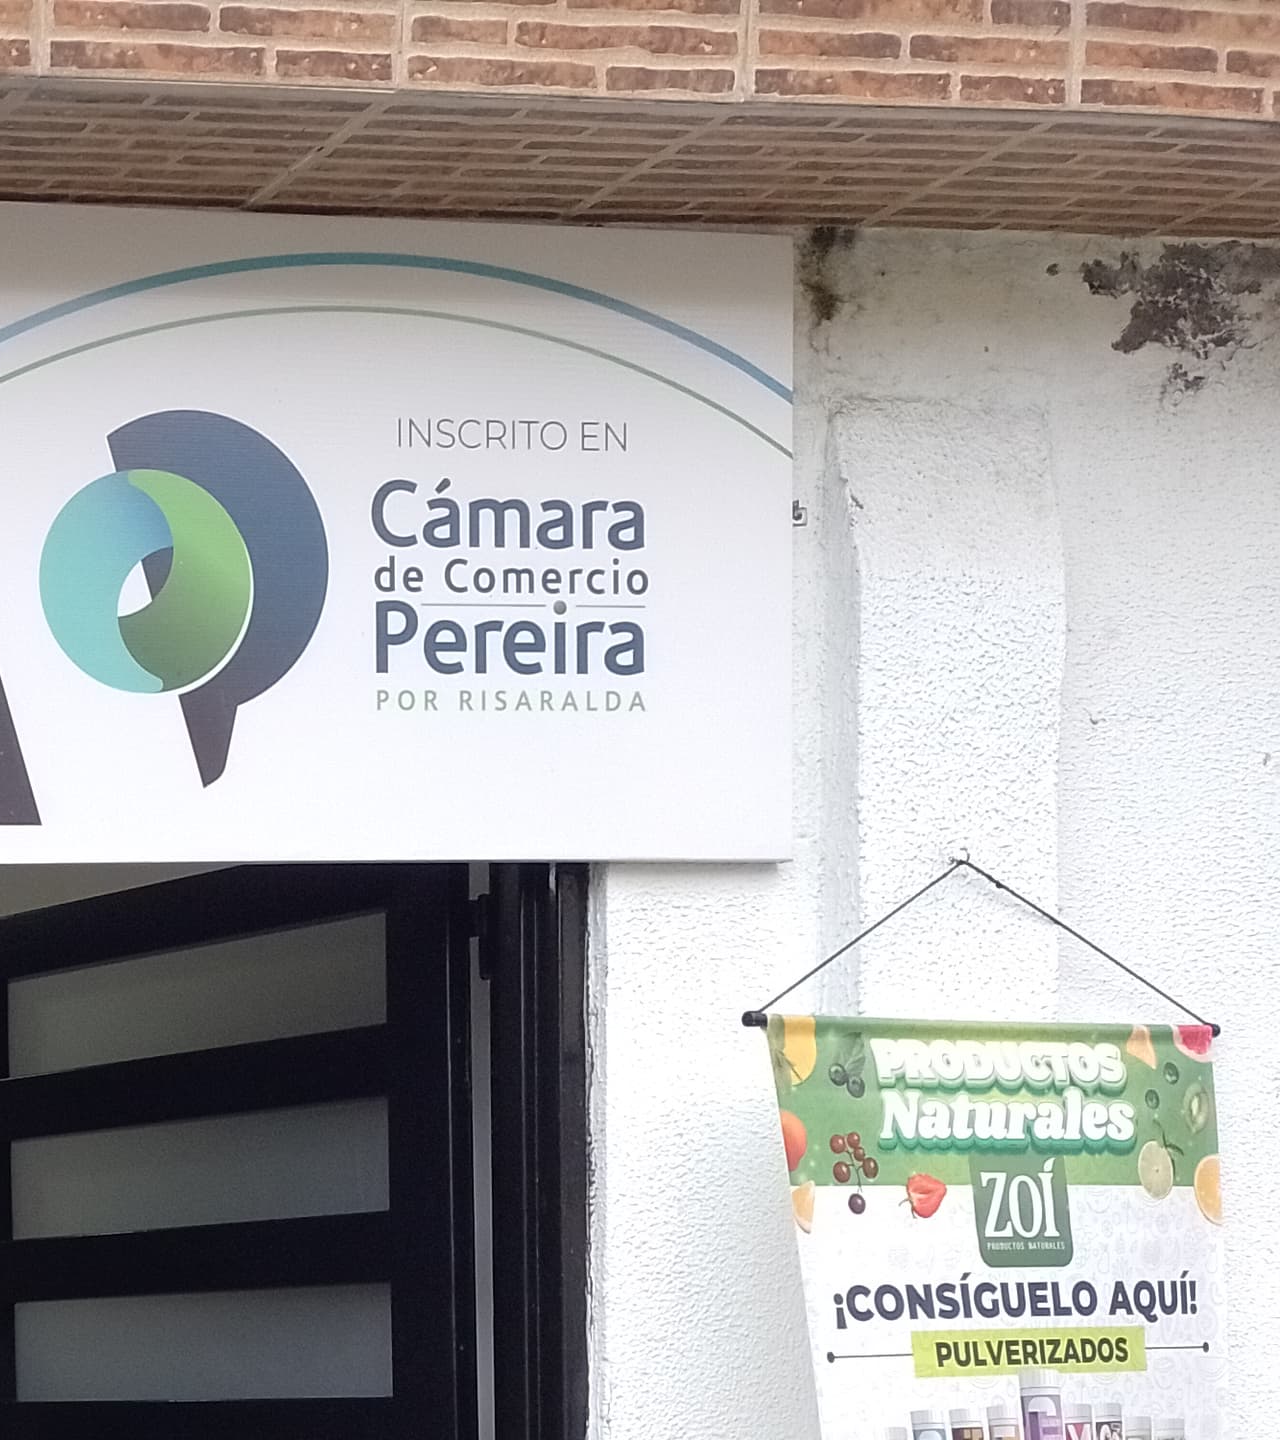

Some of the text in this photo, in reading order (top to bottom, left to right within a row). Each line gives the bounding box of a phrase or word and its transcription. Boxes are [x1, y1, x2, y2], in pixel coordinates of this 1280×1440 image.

[397, 417, 627, 452] INSCRITO EN
[371, 478, 645, 550] Cámara
[374, 555, 649, 595] de Comercio
[375, 599, 645, 676] Pereira
[376, 690, 646, 712] POR RISARALDA
[869, 1038, 1128, 1090] PRODUCTOS
[881, 1088, 1136, 1146] Naturales
[980, 1158, 1061, 1238] ZOÍ
[833, 1271, 1197, 1329] ¡CONSÍGUELO AQUÍ!
[935, 1337, 1129, 1368] PULVERIZADOS
